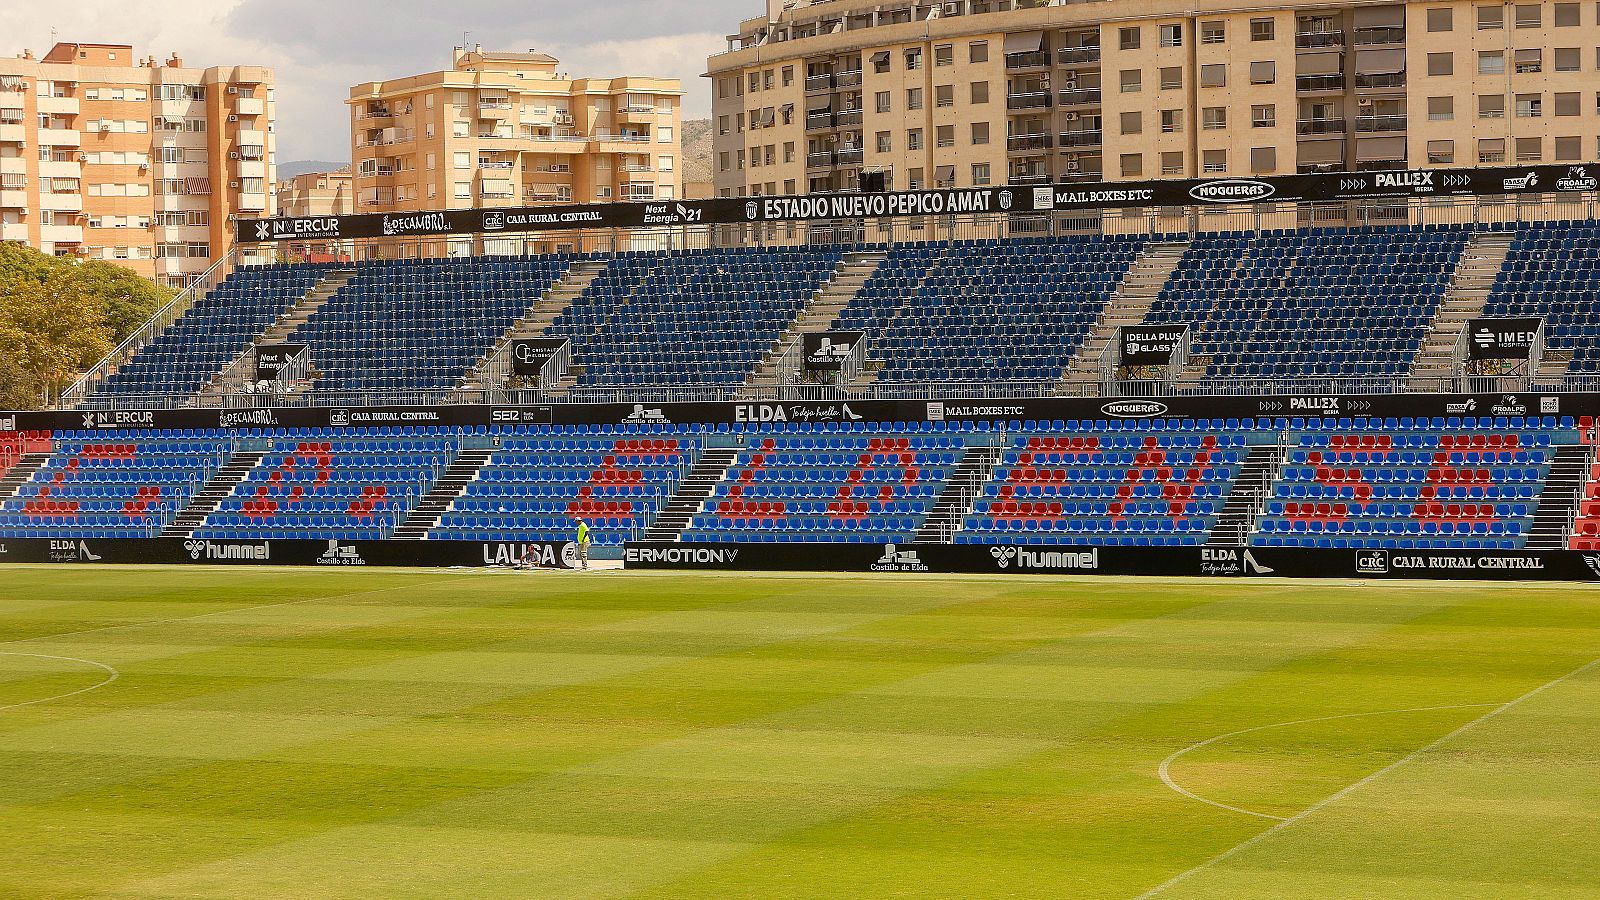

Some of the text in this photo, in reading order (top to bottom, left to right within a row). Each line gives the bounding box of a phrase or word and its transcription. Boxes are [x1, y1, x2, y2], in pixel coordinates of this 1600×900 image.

[1376, 172, 1433, 187] PALLEX
[1200, 185, 1264, 196] NOGUERAS
[1056, 193, 1088, 203] MAIL
[1090, 191, 1126, 202] BOXES
[646, 205, 667, 214] Next
[764, 191, 991, 219] ESTADIO NUEVO PEPICO AMAT
[507, 212, 602, 224] CAJA RURAL CENTRAL
[687, 209, 702, 221] 21
[274, 219, 339, 233] INVERCUR
[1127, 333, 1157, 341] IDELLA
[1499, 332, 1535, 342] IMED
[260, 354, 278, 362] Next
[807, 355, 833, 363] Castillo
[1109, 404, 1160, 413] NOGUERAS
[1290, 398, 1339, 409] PALLEX
[352, 412, 439, 421] CAJA RURAL CENTRAL
[492, 410, 520, 421] SER
[735, 405, 787, 422] ELDA
[946, 407, 972, 416] MAIL
[973, 407, 1003, 415] BOXES
[0, 414, 16, 430] el
[97, 412, 153, 423] INVERCUR
[50, 540, 75, 550] ELDA
[207, 541, 269, 560] hummel
[1018, 547, 1098, 568] hummel
[1202, 549, 1237, 561] ELDA
[317, 557, 340, 565] Castillo
[342, 557, 350, 565] de
[1359, 557, 1384, 567] CRC
[1393, 556, 1544, 568] CAJA RURAL CENTRAL
[871, 563, 899, 571] Castillo
